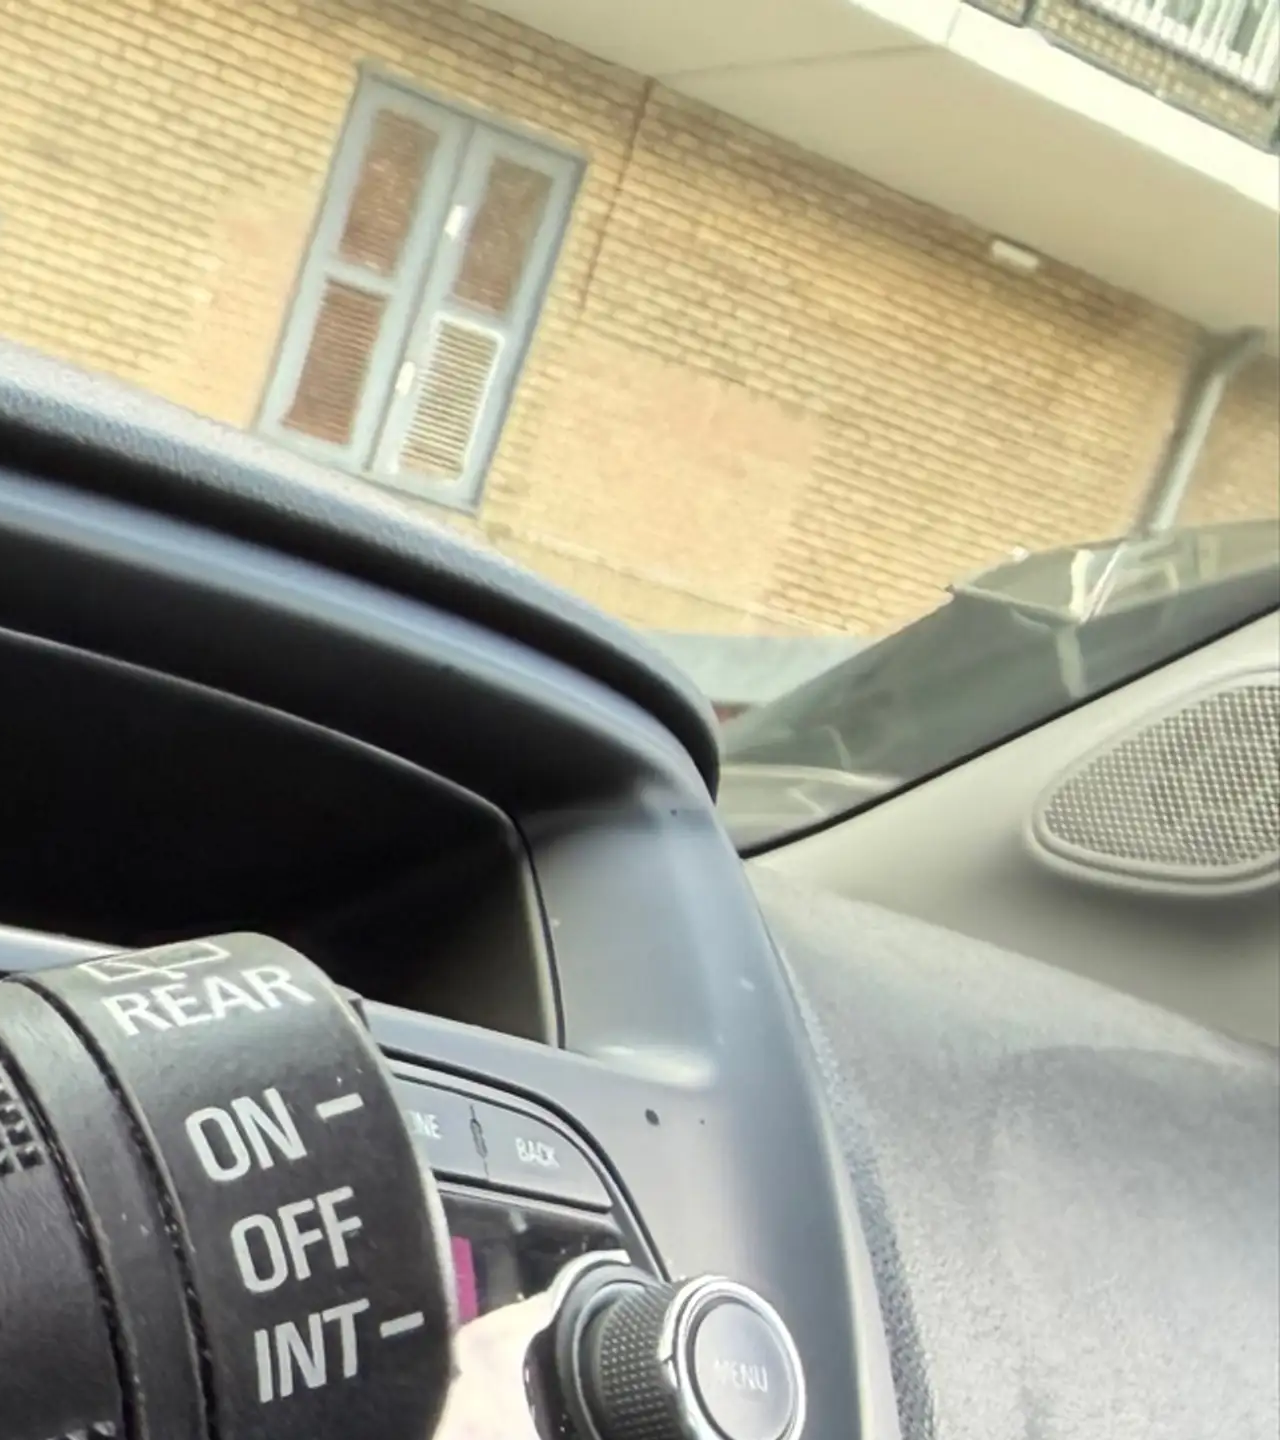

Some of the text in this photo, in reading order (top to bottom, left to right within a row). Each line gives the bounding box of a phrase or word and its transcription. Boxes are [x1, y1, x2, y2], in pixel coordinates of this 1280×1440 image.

[100, 964, 317, 1039] REAR
[185, 1086, 309, 1183] ON
[514, 1136, 561, 1169] BACK
[230, 1186, 365, 1294] OFF
[254, 1298, 371, 1404] INT
[711, 1358, 769, 1393] MENU
